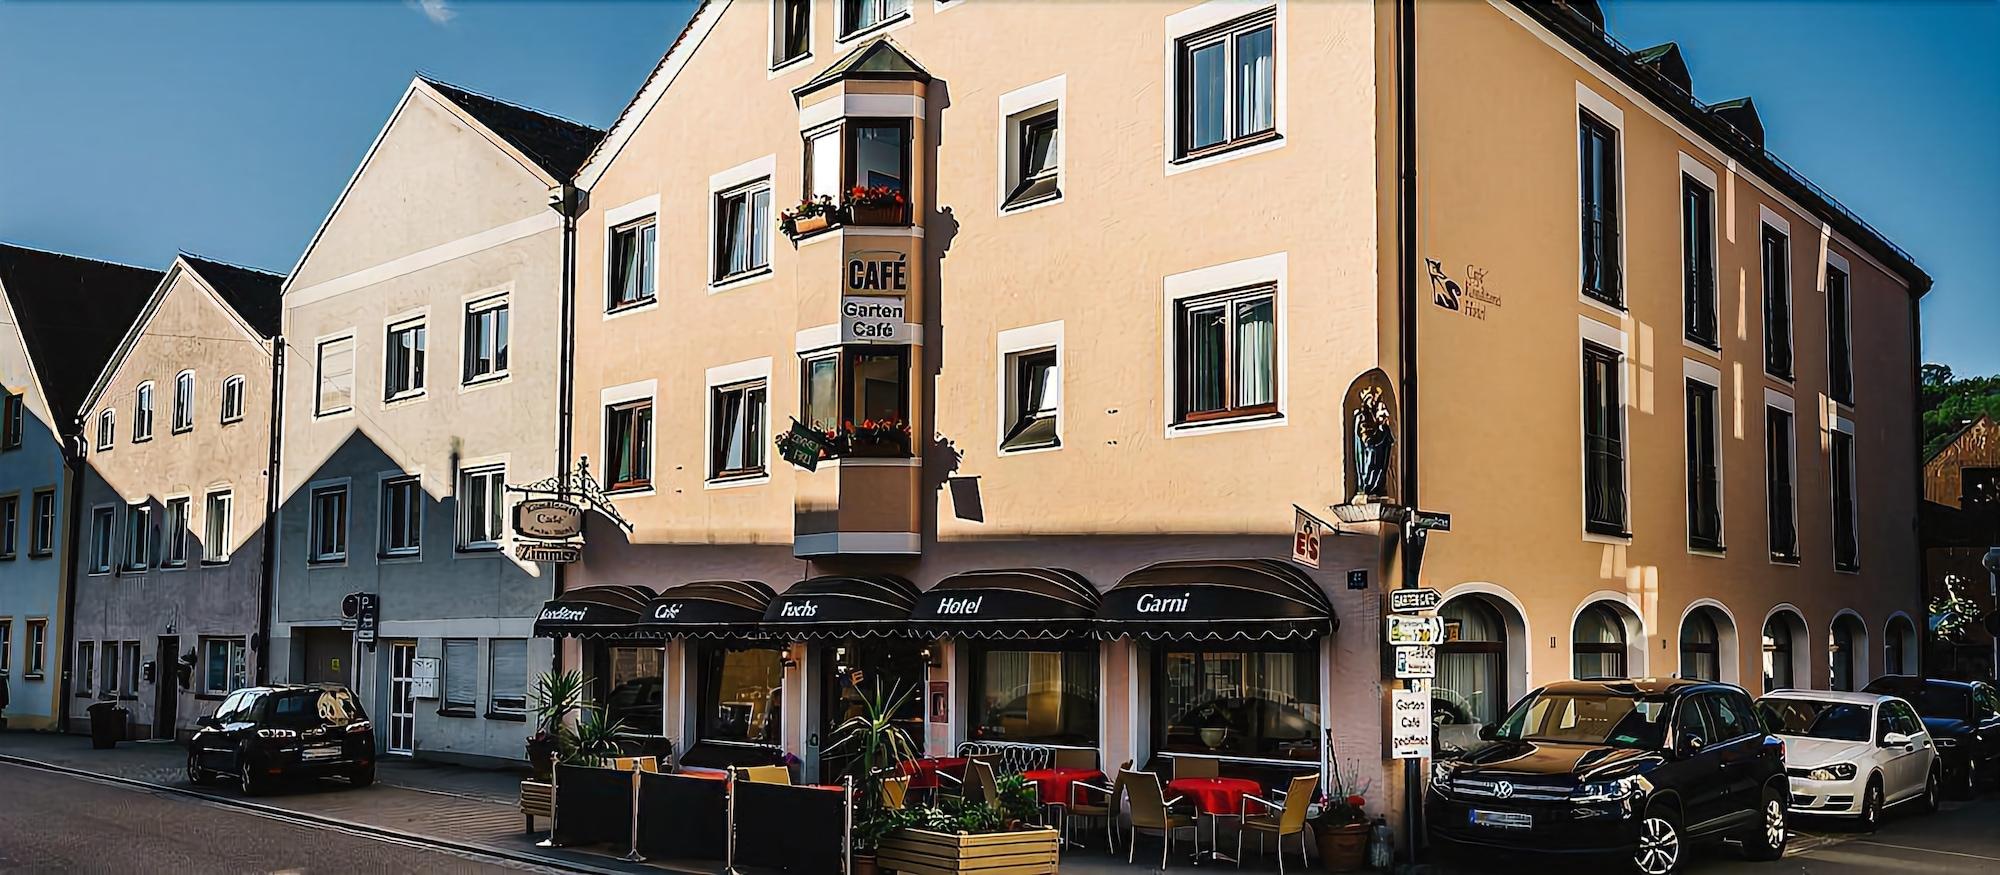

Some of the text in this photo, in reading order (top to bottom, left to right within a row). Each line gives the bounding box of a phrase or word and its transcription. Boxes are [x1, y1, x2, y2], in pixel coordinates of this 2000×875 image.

[849, 253, 907, 291] CAFÉ
[843, 302, 903, 318] Garten
[853, 321, 893, 338] Café
[781, 600, 818, 617] Fuchs
[937, 596, 983, 614] Hotel
[1136, 592, 1190, 613] Garni
[1394, 735, 1429, 749] genet
